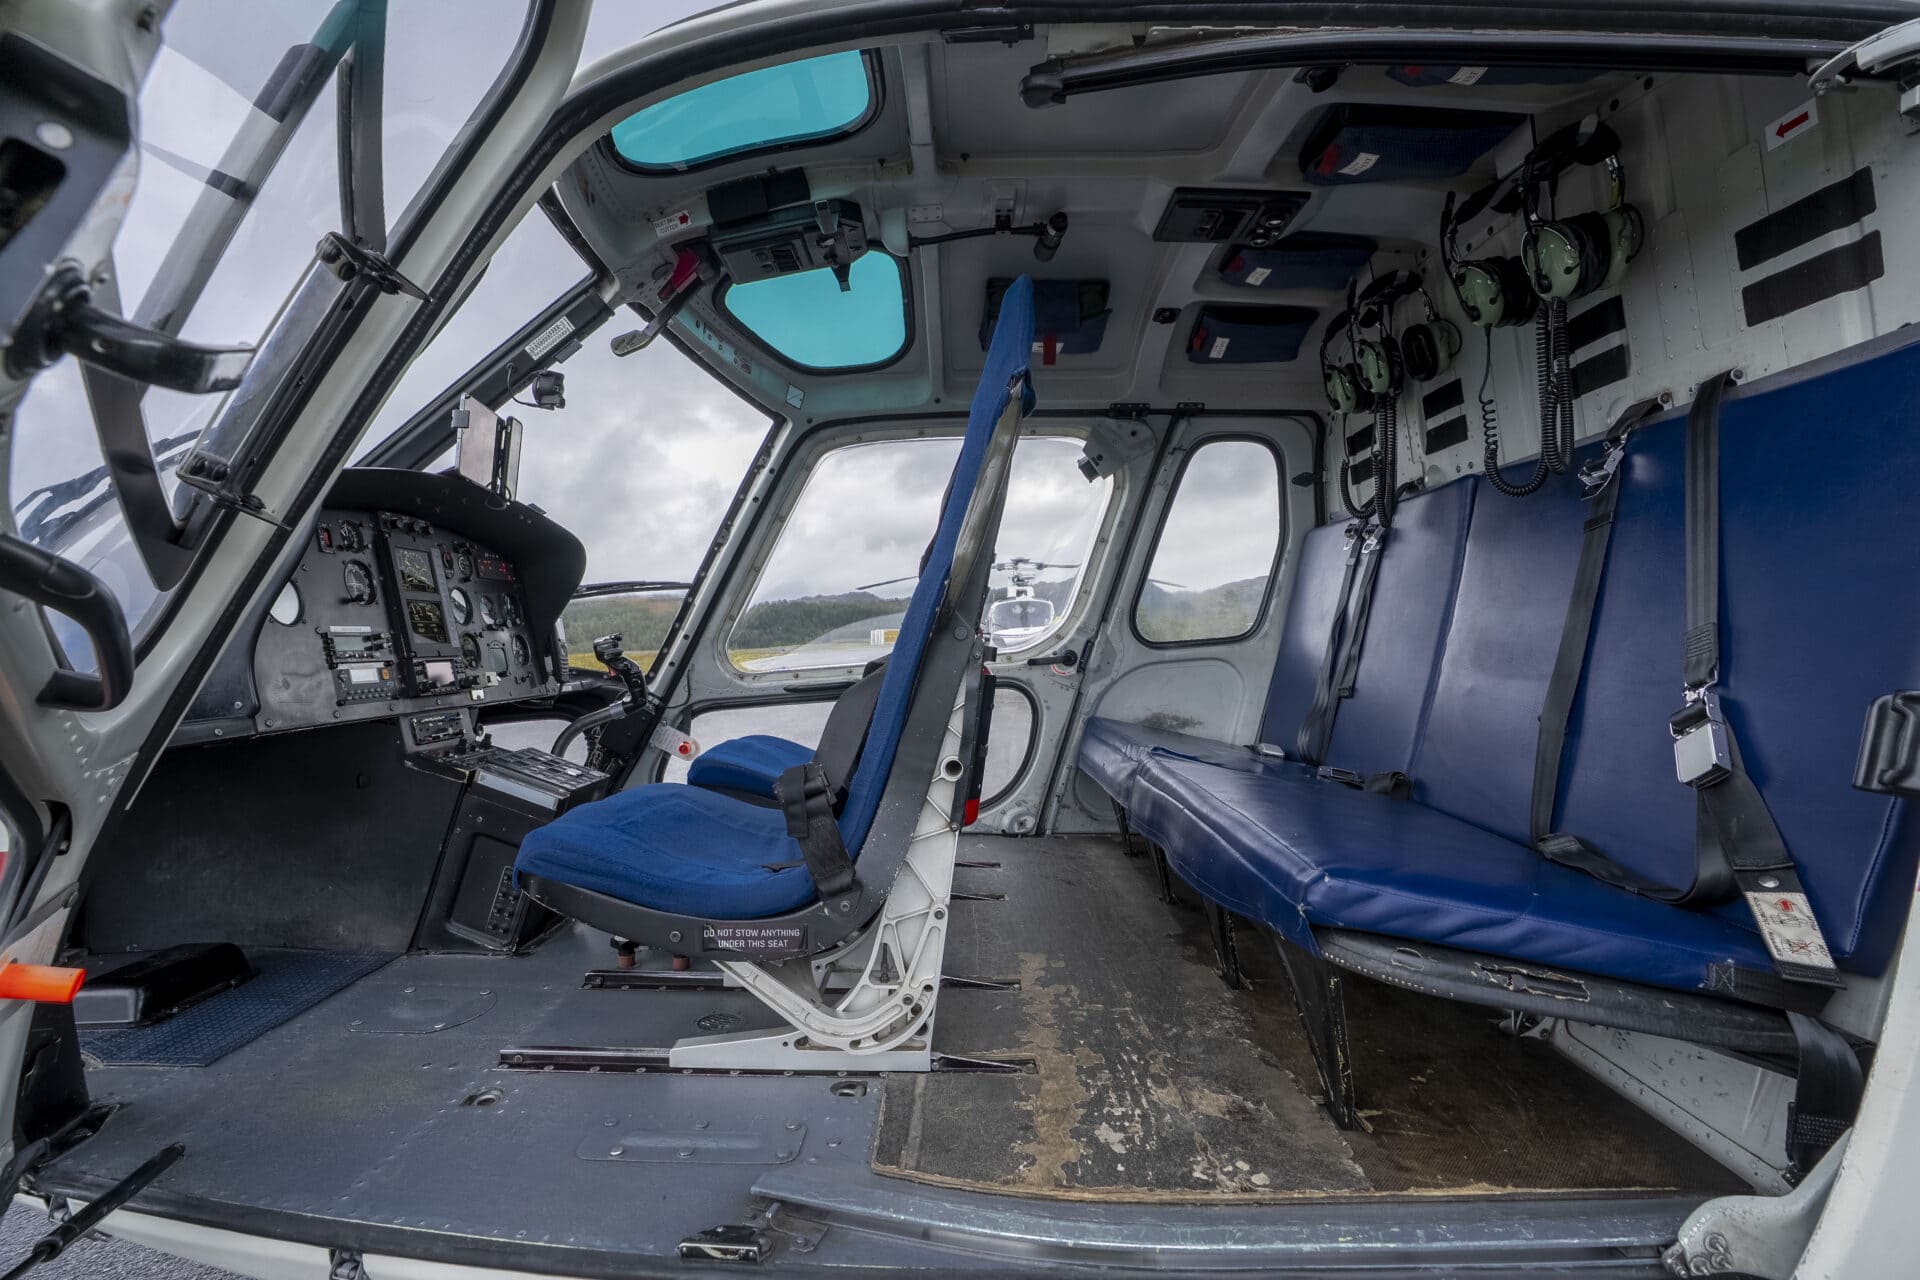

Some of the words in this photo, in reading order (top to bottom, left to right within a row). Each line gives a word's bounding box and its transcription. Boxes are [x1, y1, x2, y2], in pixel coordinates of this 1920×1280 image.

[703, 929, 715, 938] DO
[717, 928, 734, 937] NOT
[735, 928, 759, 937] STOW
[760, 928, 800, 937] ANYTHING
[718, 939, 745, 948] UNDER
[747, 939, 765, 948] THIS
[767, 939, 789, 948] SEAT
